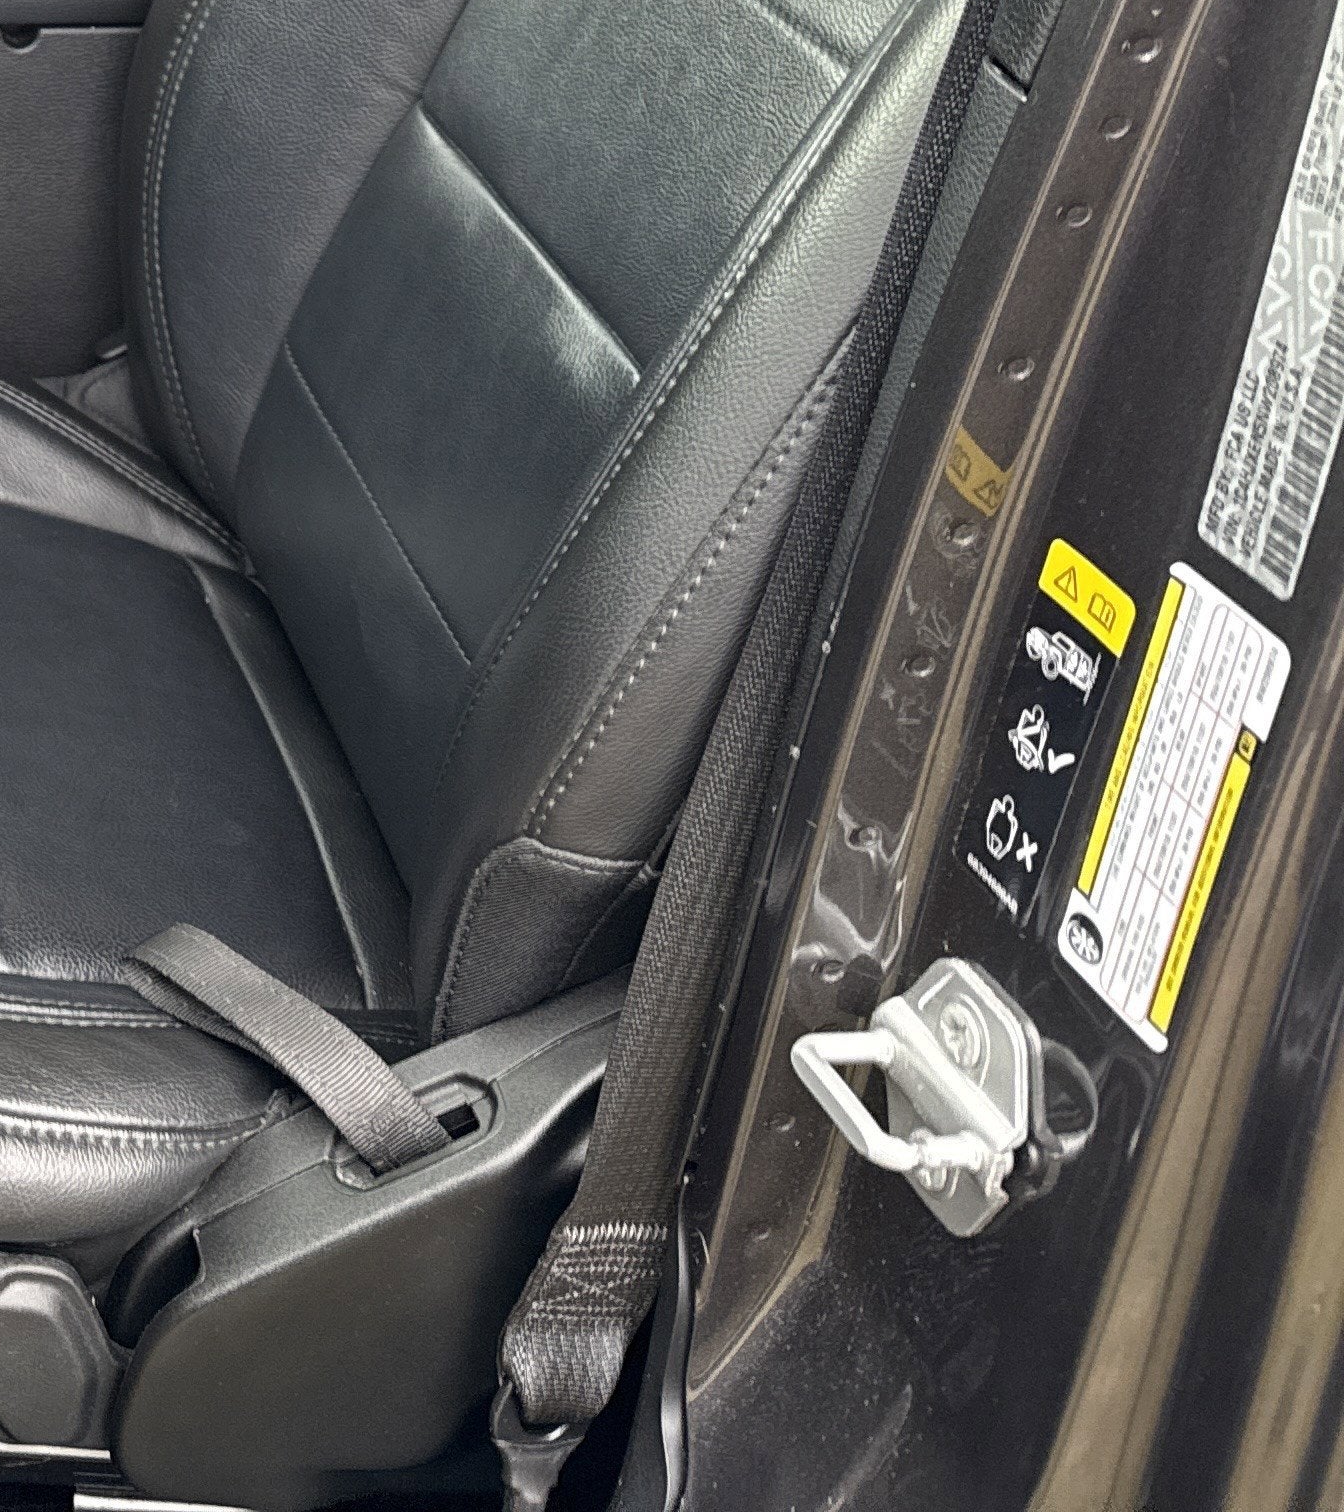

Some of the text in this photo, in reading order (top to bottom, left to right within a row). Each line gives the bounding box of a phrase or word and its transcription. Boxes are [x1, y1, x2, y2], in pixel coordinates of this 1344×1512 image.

[1238, 369, 1260, 407] LLC
[1233, 400, 1252, 429] US
[1224, 426, 1244, 465] FCA
[1206, 498, 1226, 536] MFD
[1239, 489, 1268, 559] VEHICLE
[1258, 440, 1283, 489] MADE
